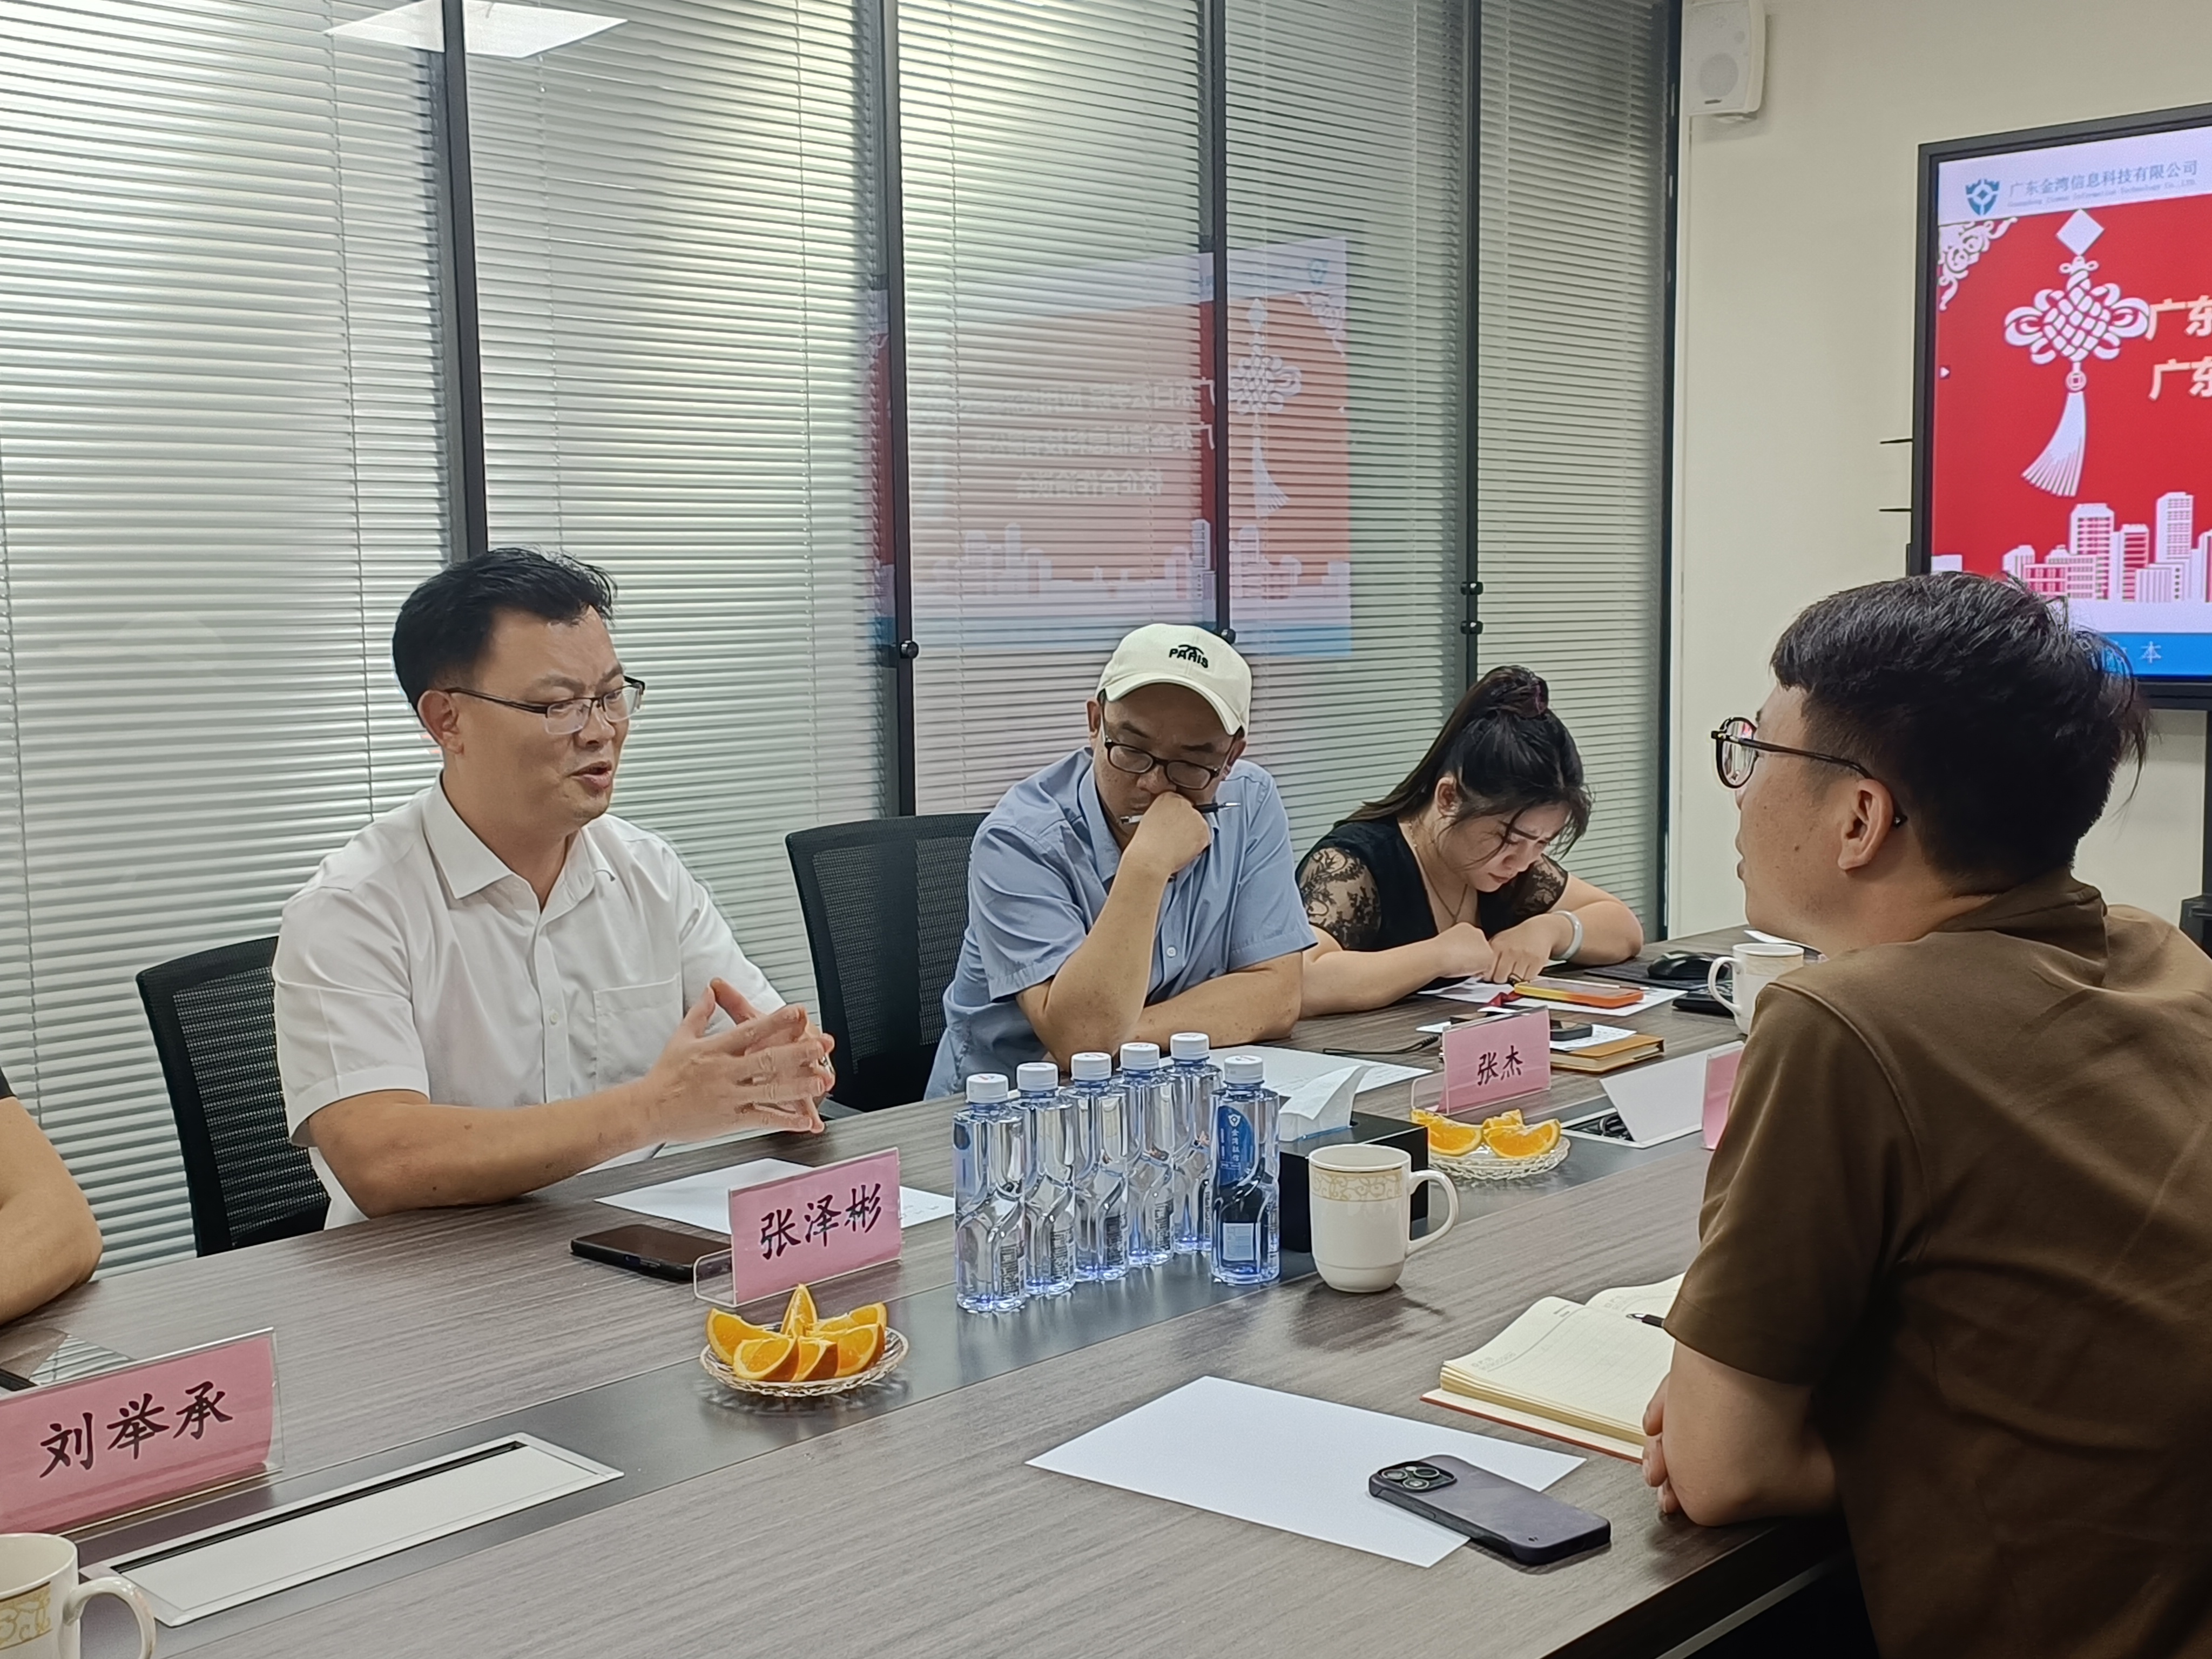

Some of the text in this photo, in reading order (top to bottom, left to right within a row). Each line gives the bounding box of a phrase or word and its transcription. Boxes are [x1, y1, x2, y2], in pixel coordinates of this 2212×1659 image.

[2009, 159, 2197, 197] 广东金湾信息科技有限公司
[2144, 295, 2212, 341] 广东
[1169, 645, 1209, 669] PARIS
[1478, 1045, 1523, 1086] 张杰
[760, 1183, 881, 1260] 张泽彬
[39, 1381, 233, 1478] 刘举承
